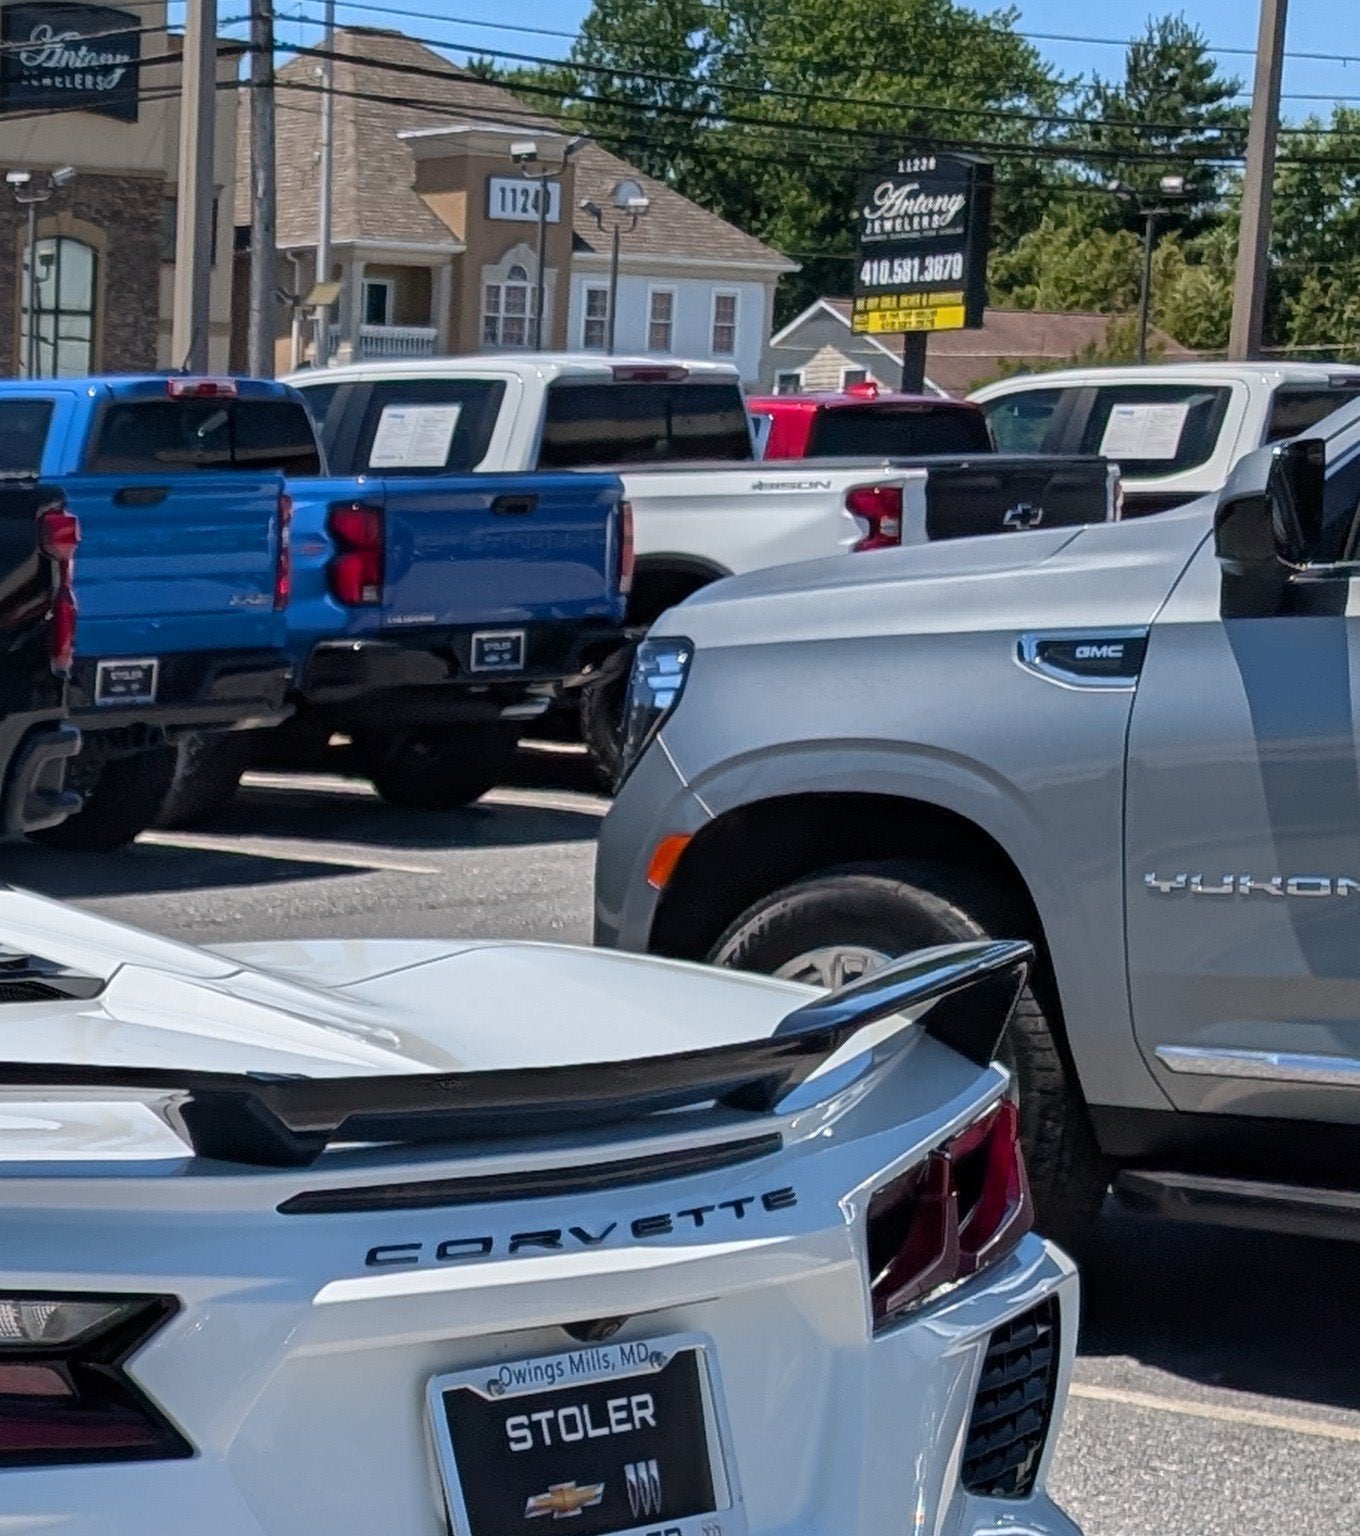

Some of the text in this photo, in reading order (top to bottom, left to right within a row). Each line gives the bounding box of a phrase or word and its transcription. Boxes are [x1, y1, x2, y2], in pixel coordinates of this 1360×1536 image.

[863, 181, 966, 227] Antony
[1075, 644, 1124, 659] GMC
[364, 1186, 799, 1267] CORVETTE
[499, 1342, 649, 1387] Owings Mills, MD
[506, 1393, 657, 1452] STOLER
